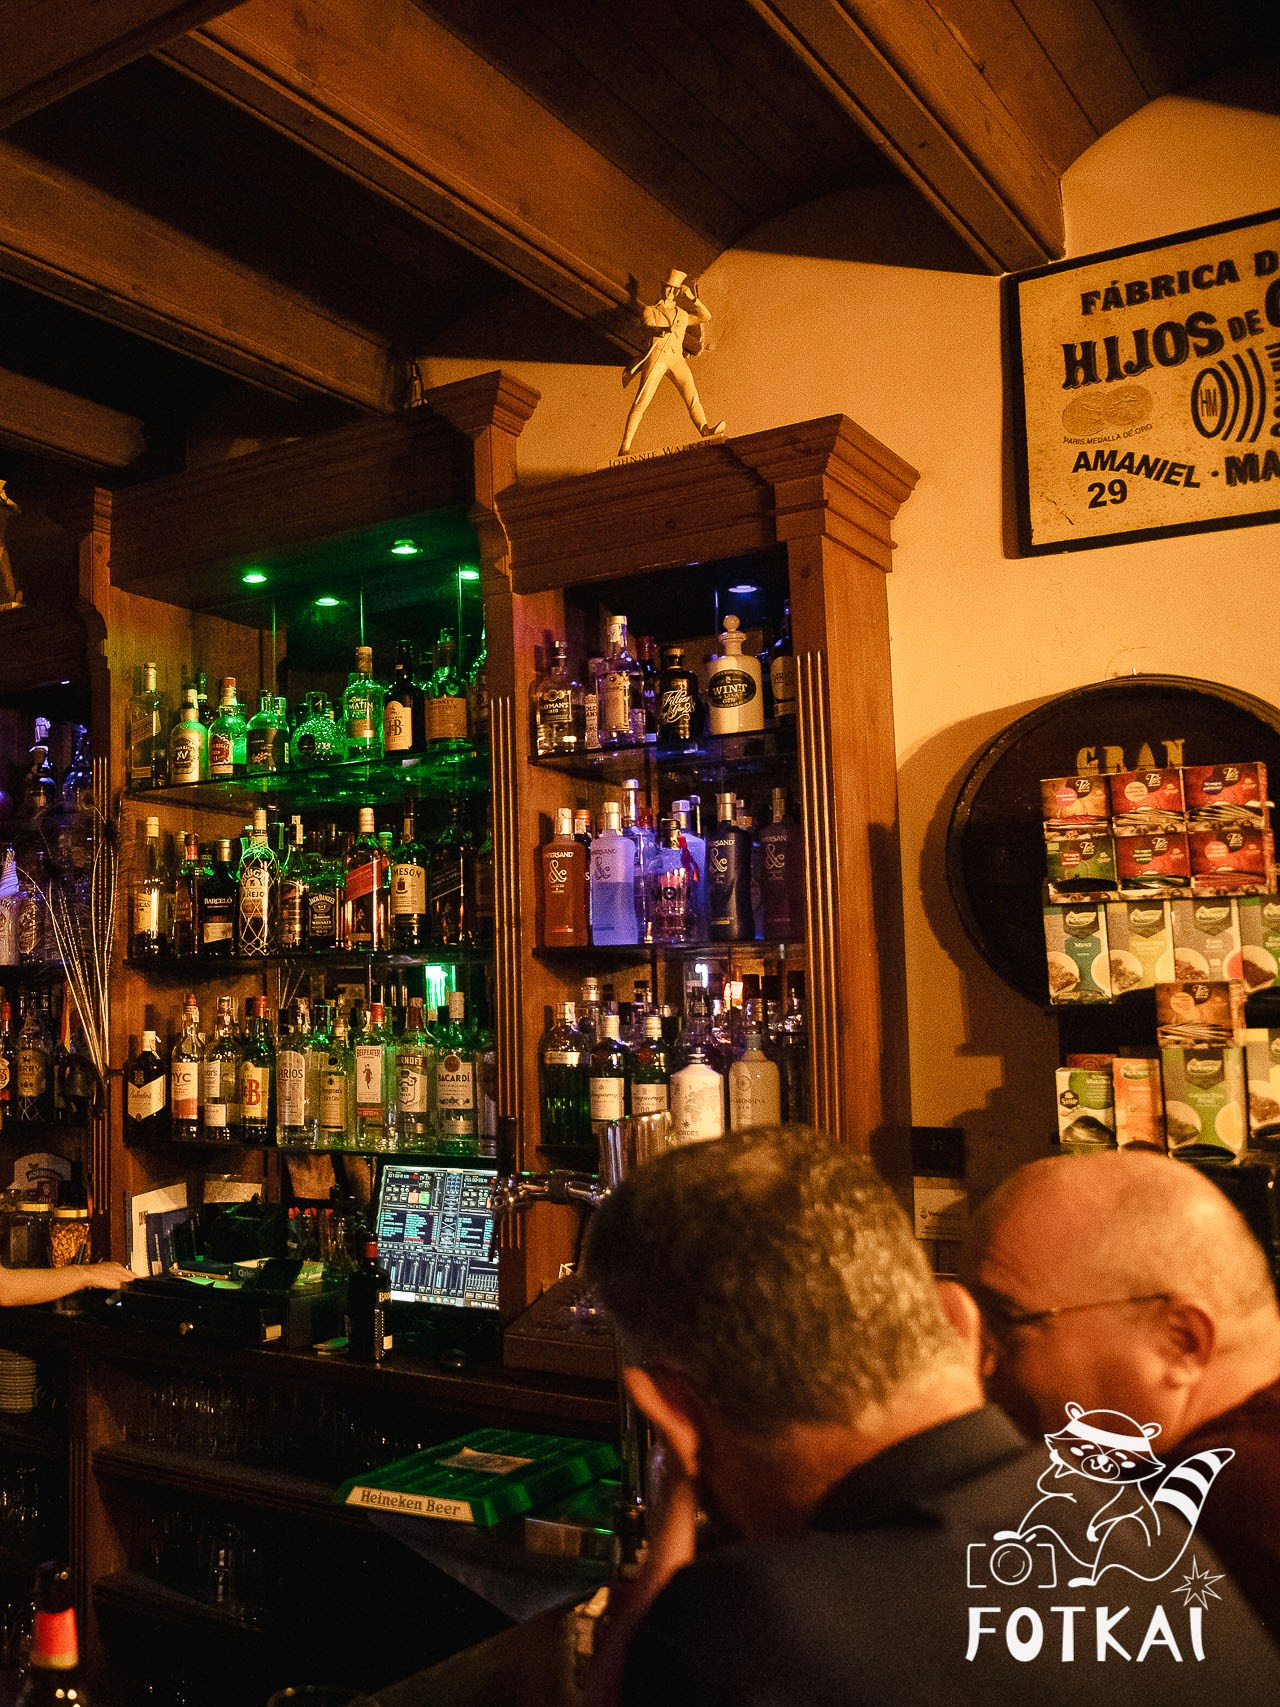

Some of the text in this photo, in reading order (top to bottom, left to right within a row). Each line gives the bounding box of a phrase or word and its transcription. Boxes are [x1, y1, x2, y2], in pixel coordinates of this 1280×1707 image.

[1080, 259, 1241, 316] FÁBRICA
[1062, 310, 1225, 390] HIJOS
[1227, 308, 1265, 342] DE
[662, 439, 713, 457] WALKER
[1072, 449, 1202, 488] AMANIEL
[1087, 478, 1128, 509] 29
[393, 867, 422, 878] MESON
[278, 1068, 304, 1079] ARIOS
[399, 1056, 423, 1066] RNOFF
[361, 1489, 461, 1516] Heineken Beer
